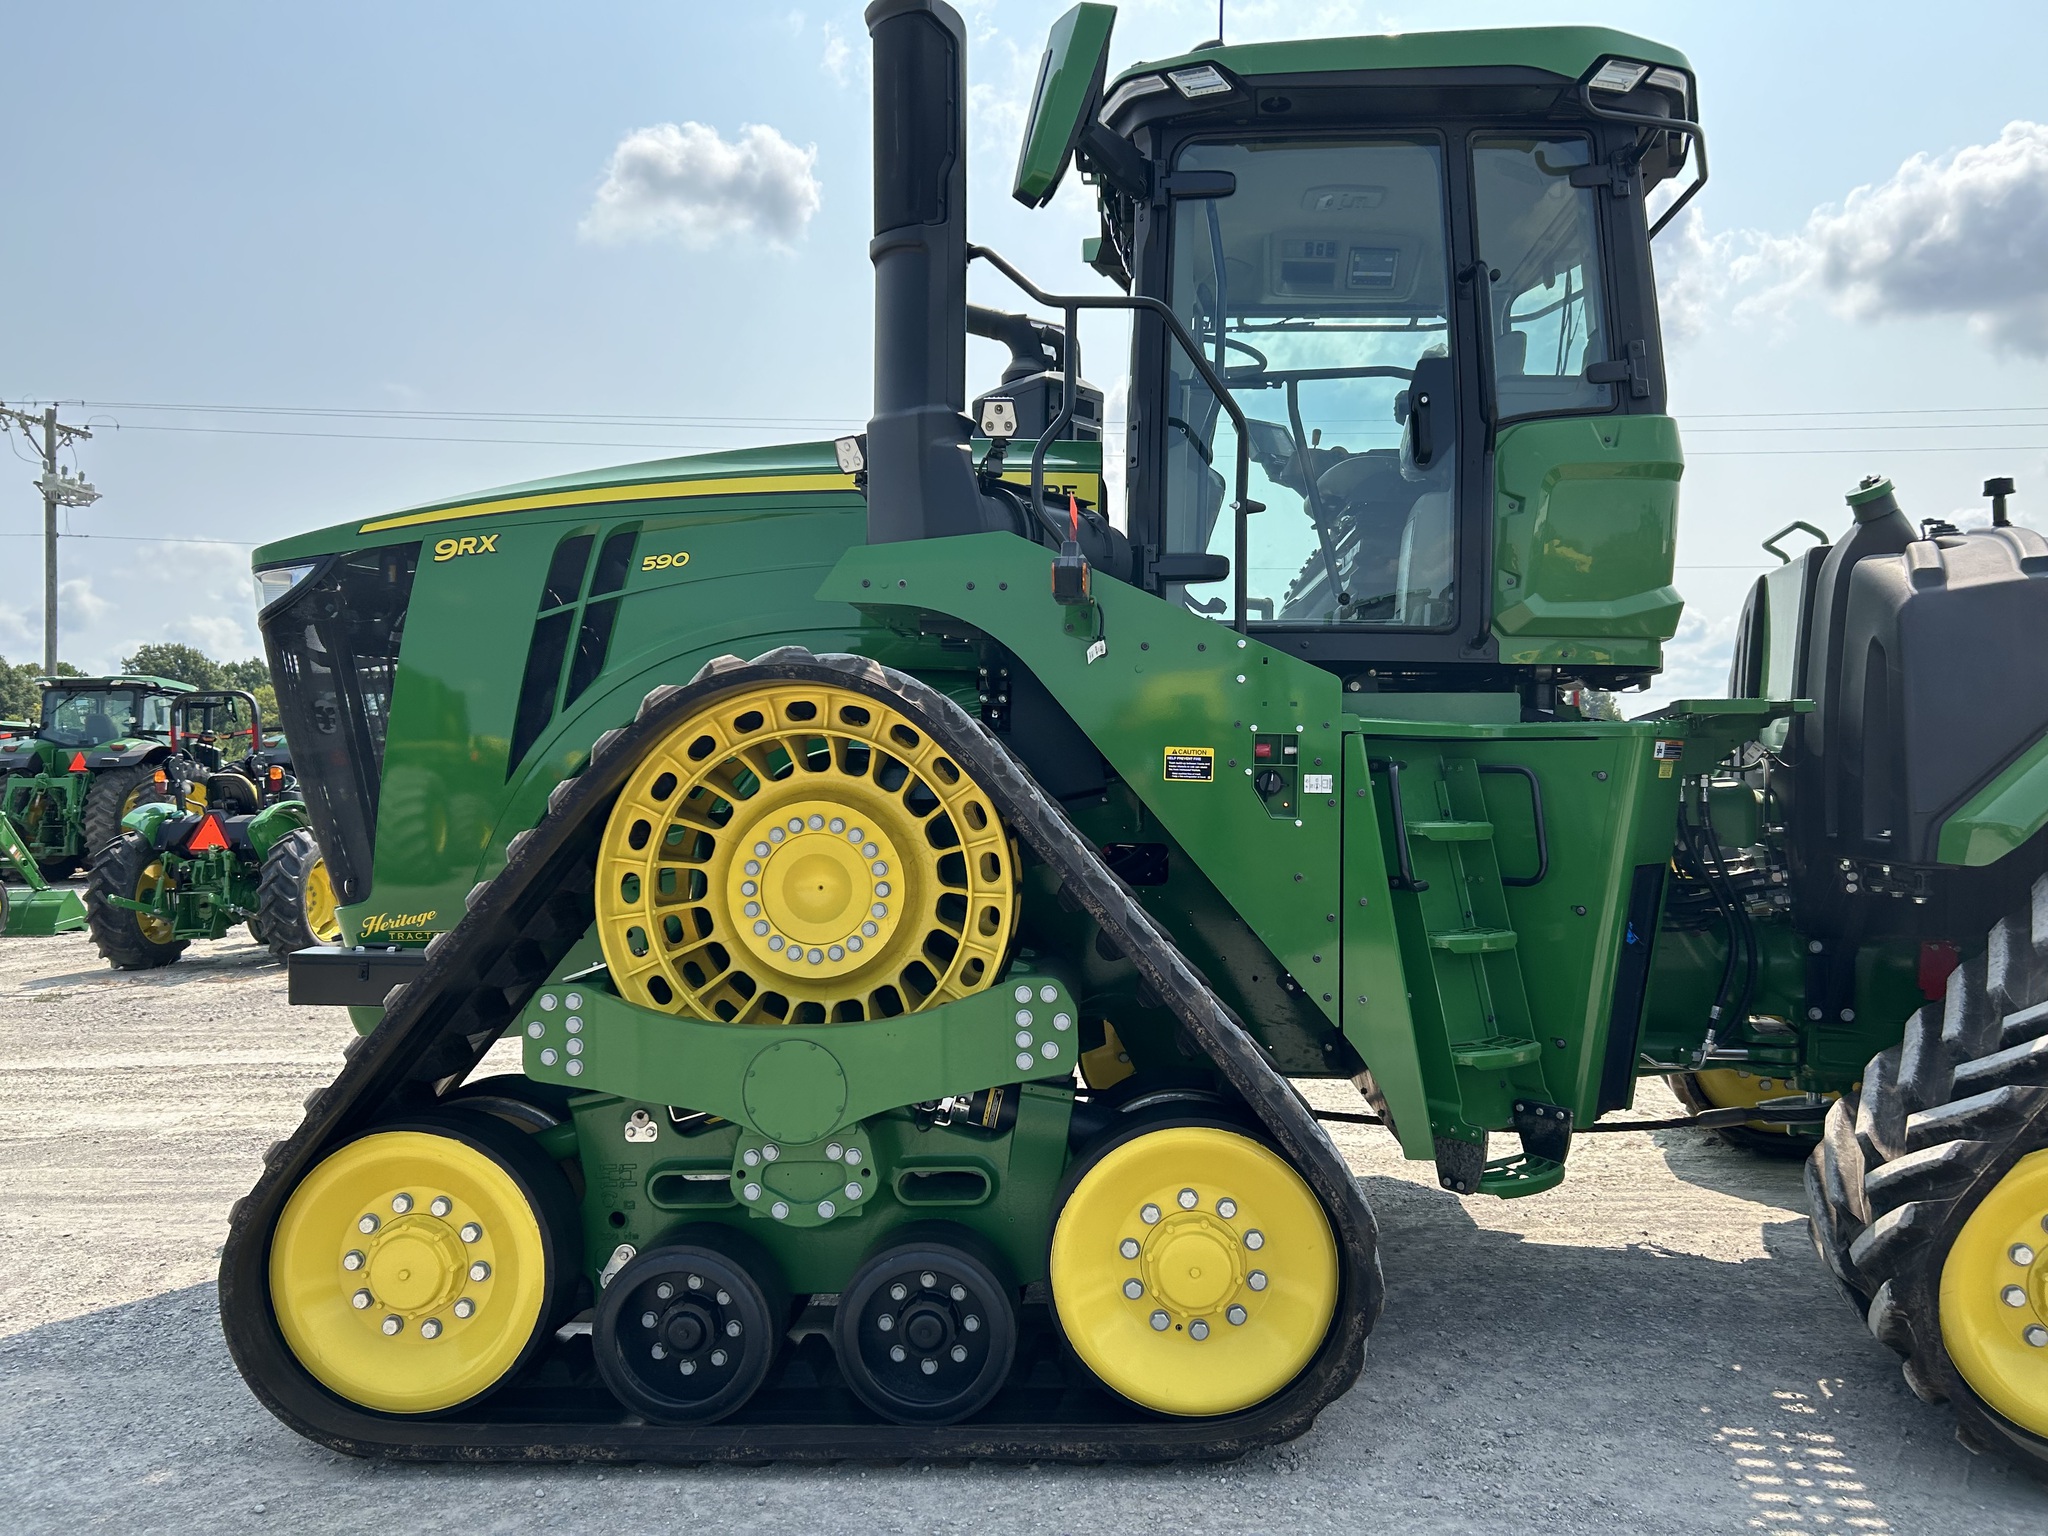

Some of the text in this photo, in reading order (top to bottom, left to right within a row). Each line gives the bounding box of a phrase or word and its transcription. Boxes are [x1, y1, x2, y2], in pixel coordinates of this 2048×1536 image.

[433, 533, 501, 562] 9RX
[641, 551, 690, 572] 590
[361, 910, 437, 938] Heritage
